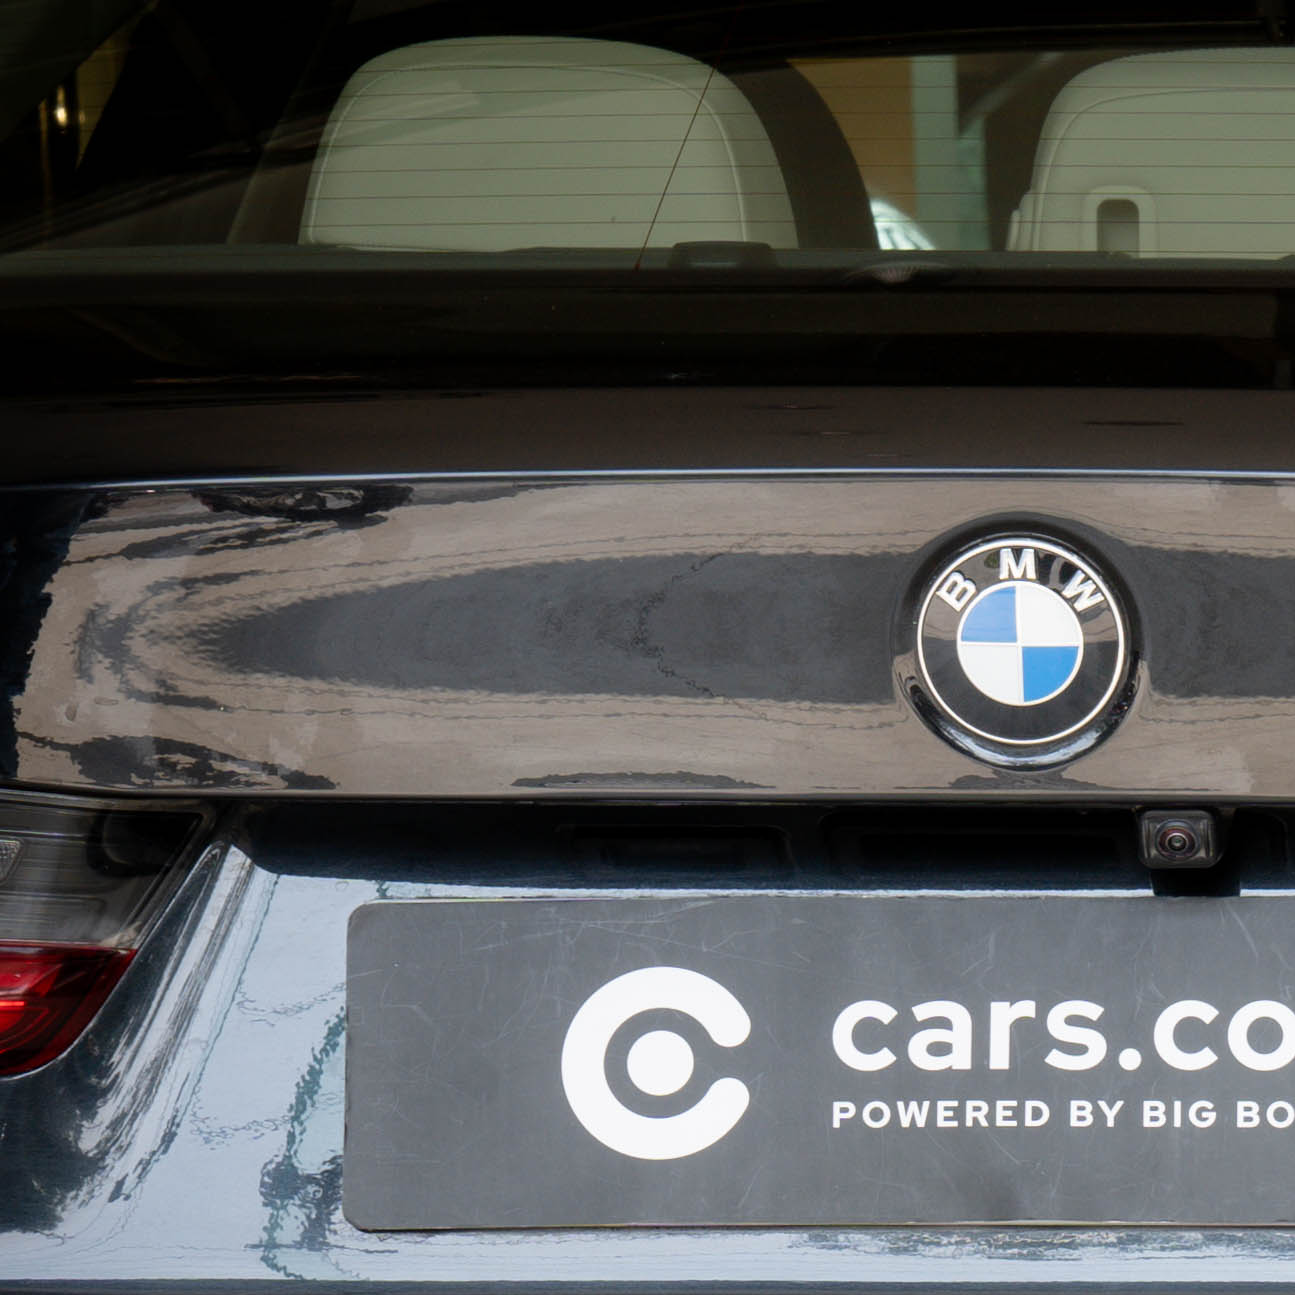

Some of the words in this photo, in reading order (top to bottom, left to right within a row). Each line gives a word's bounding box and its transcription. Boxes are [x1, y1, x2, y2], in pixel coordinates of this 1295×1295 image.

[935, 547, 1105, 613] BMW
[832, 1099, 1051, 1129] POWERED
[1069, 1099, 1125, 1128] BY
[1142, 1099, 1217, 1129] BIG
